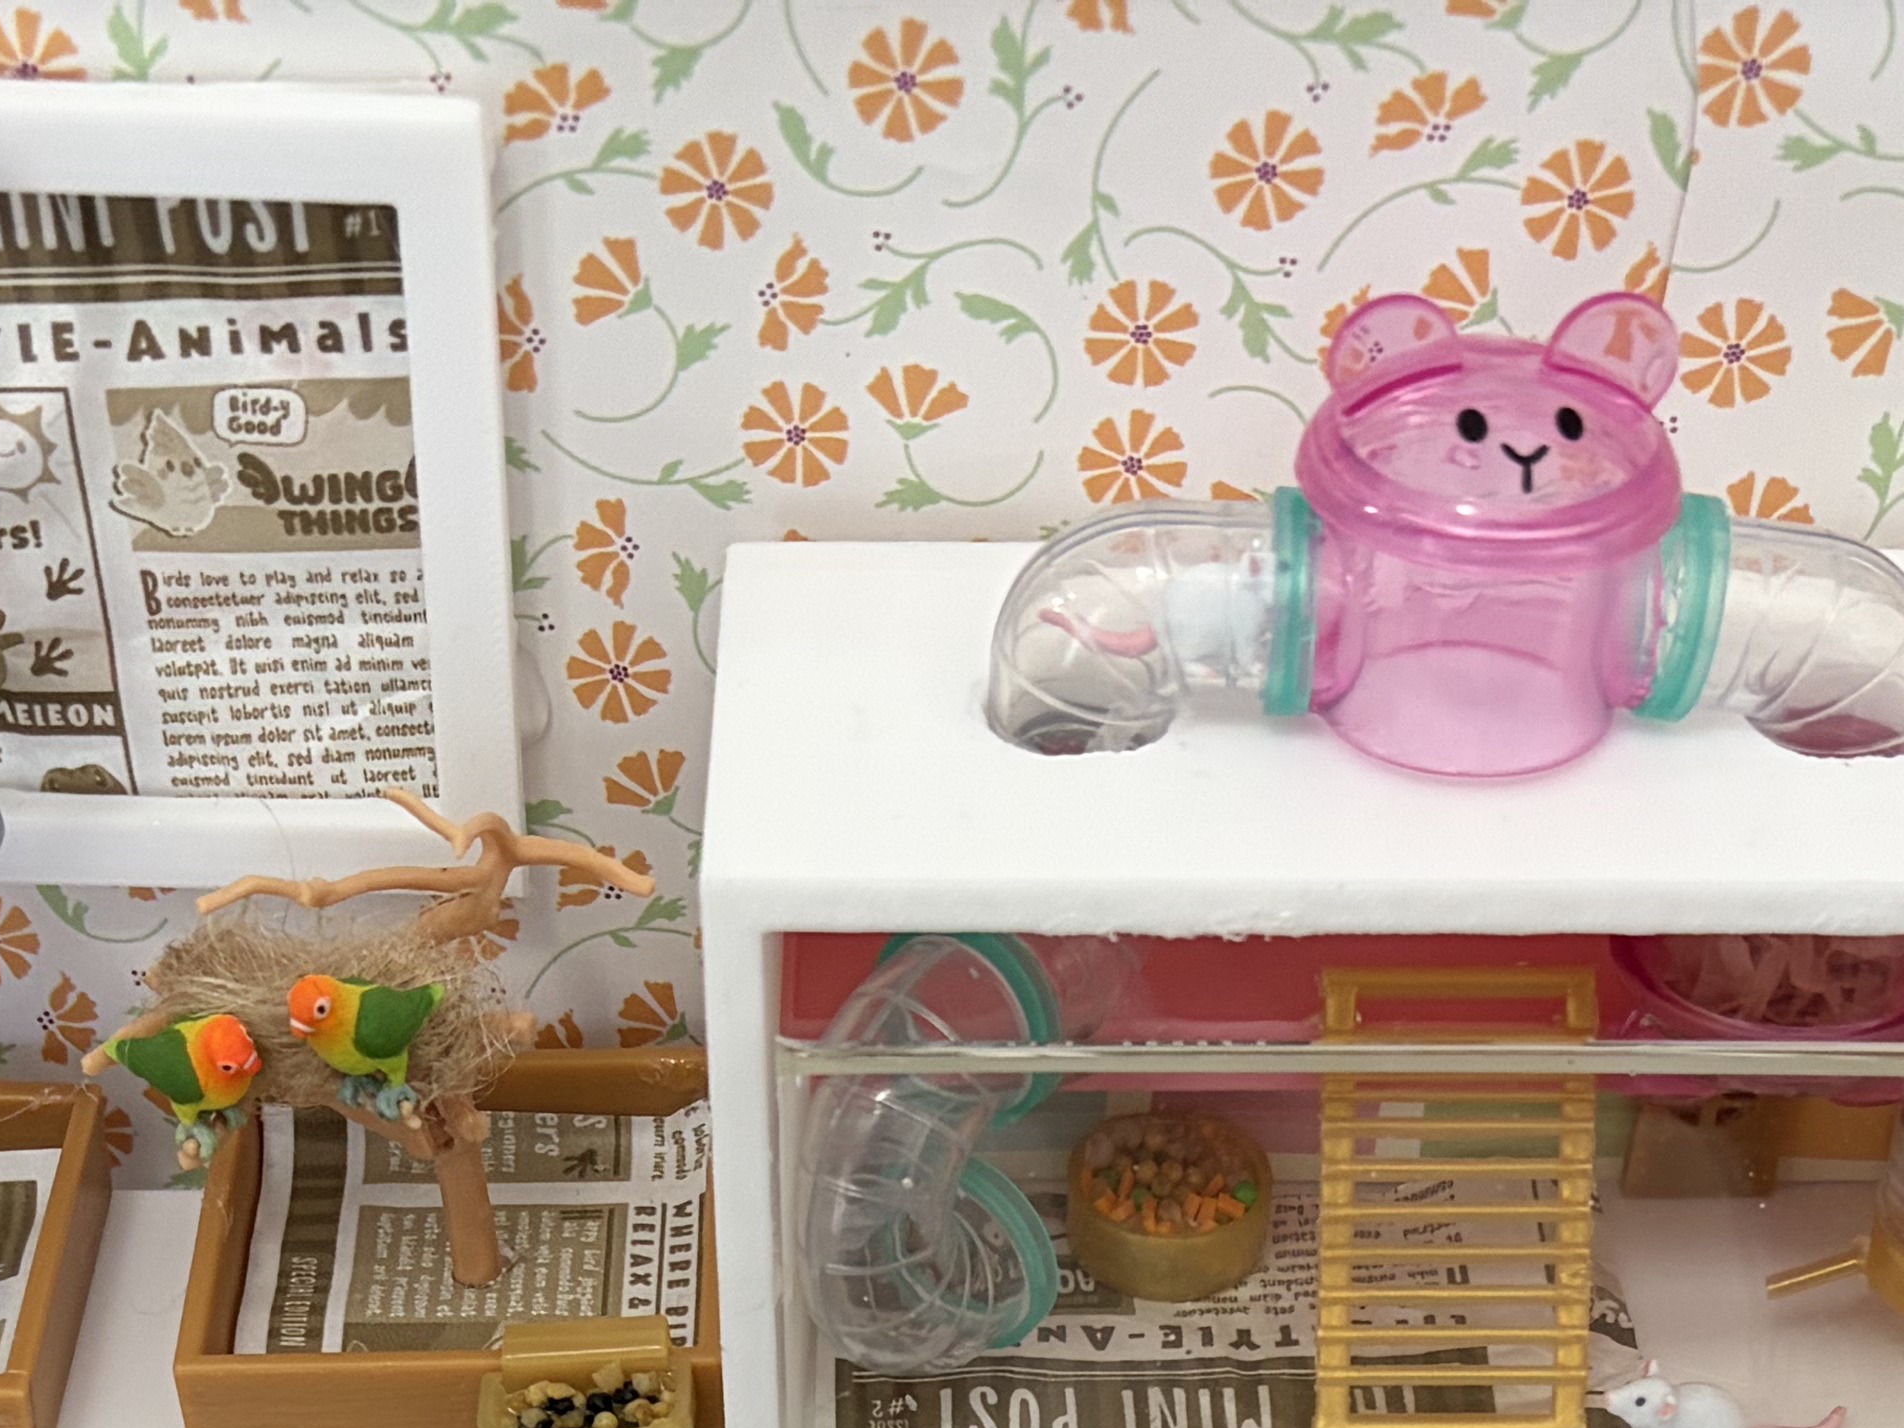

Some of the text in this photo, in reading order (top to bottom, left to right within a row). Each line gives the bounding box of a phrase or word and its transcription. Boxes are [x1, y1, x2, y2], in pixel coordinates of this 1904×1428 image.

[228, 416, 282, 437] Good
[277, 505, 419, 536] THINGS
[200, 572, 229, 587] love
[239, 571, 256, 586] to
[265, 570, 296, 588] play
[306, 567, 332, 584] and
[341, 568, 378, 584] relax
[390, 570, 407, 583] so
[394, 588, 419, 605] sed
[235, 611, 269, 628] nibh
[283, 609, 345, 626] euismod
[151, 632, 414, 654] laoreet dolore magna aliquam
[291, 658, 327, 673] enim
[335, 654, 351, 672] ad
[359, 657, 403, 672] minim
[199, 679, 260, 700] nostrud
[270, 681, 314, 696] exerci
[324, 680, 371, 695] tation
[161, 706, 219, 725] suscipit
[230, 703, 291, 721] lobortis
[303, 701, 330, 717] nisl
[341, 701, 358, 716] ut
[162, 730, 206, 747] lorem
[212, 731, 252, 747] ipsum
[258, 726, 296, 743] dolor
[303, 724, 323, 742] sit
[288, 747, 313, 767] sed
[321, 747, 355, 764] diam
[246, 771, 314, 786] tincidunt
[331, 769, 347, 785] ut
[363, 765, 416, 783] laoreet
[629, 1206, 657, 1287] RELAX
[667, 1200, 694, 1290] WHERE
[280, 1301, 312, 1346] EDITION
